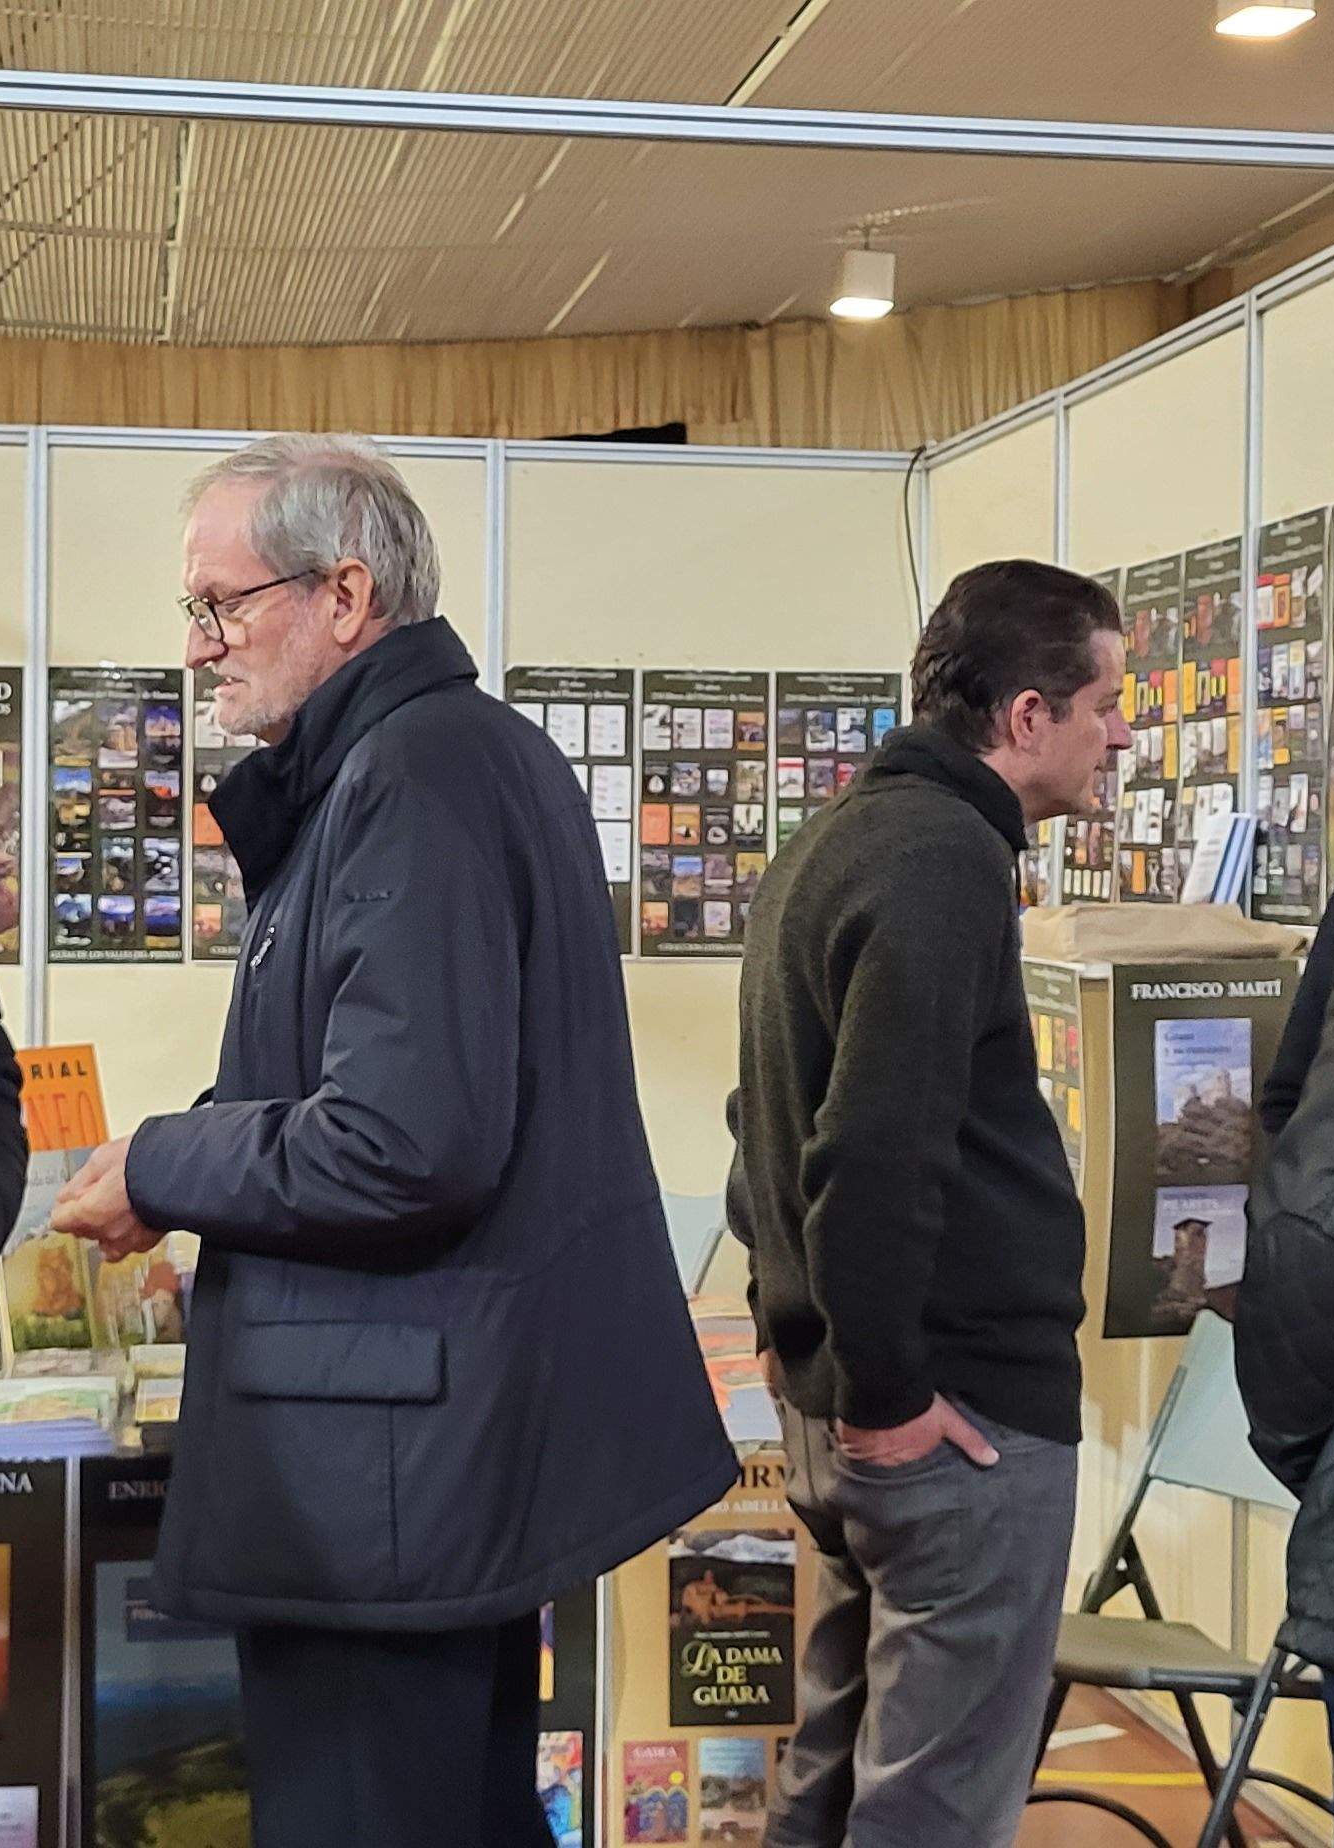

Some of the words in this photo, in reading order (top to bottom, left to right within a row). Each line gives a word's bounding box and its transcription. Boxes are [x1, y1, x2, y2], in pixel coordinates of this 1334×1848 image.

[1130, 981, 1225, 1000] FRANCISCO
[1227, 978, 1283, 998] MARTÍ
[30, 1060, 88, 1080] RIAL
[725, 1646, 784, 1665] DAMA
[716, 1665, 747, 1685] DE
[692, 1685, 771, 1707] GUARA
